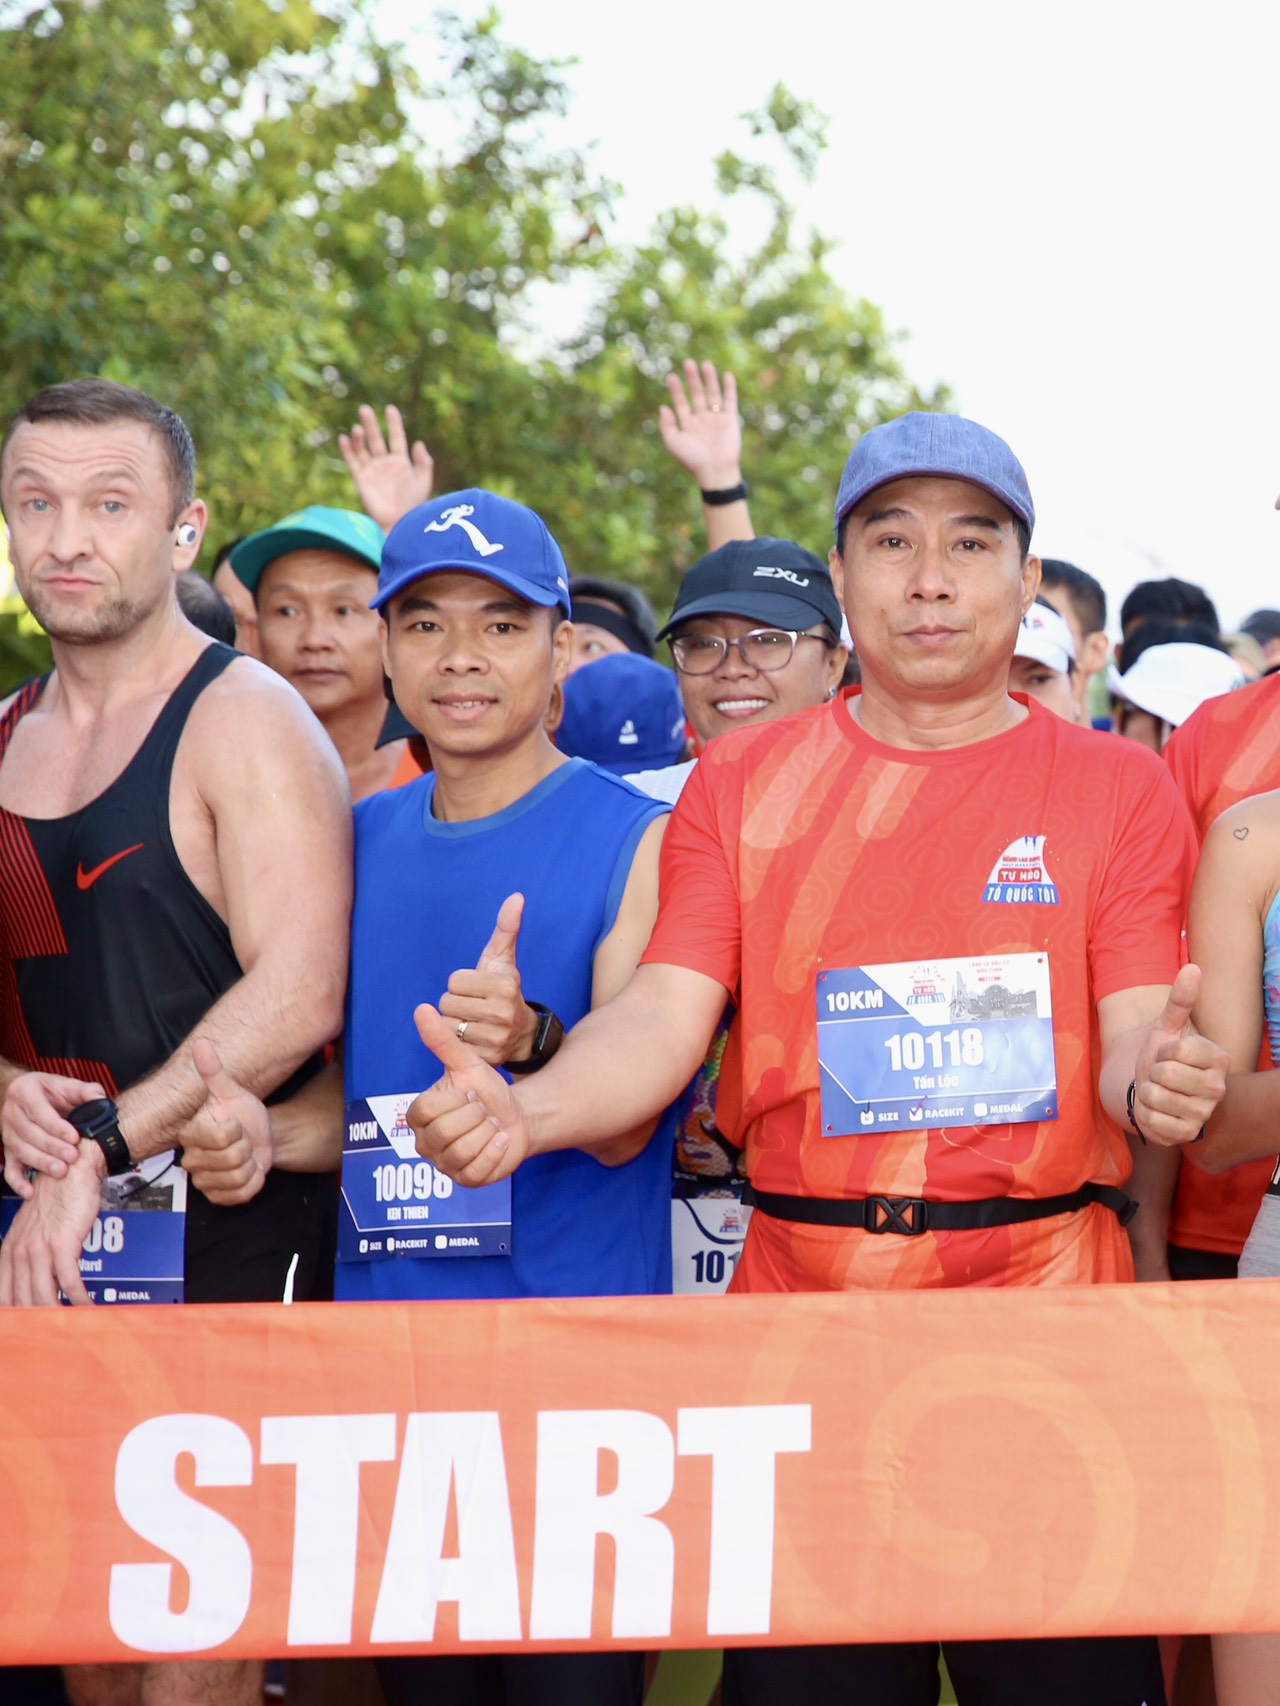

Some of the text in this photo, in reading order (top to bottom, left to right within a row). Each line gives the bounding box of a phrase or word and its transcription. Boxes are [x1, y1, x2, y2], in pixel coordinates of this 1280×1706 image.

[753, 566, 809, 587] 2XU
[826, 989, 884, 1012] 10KM
[885, 1028, 984, 1071] 10118
[878, 1111, 899, 1122] SIZE
[925, 1107, 965, 1119] RACEKIT
[990, 1104, 1023, 1115] MEDAL
[349, 1121, 378, 1142] 10KM
[372, 1162, 453, 1202] 10098
[387, 1205, 429, 1221] KEN THIEN
[370, 1240, 382, 1250] SIZE
[395, 1238, 428, 1249] RACEKIT
[449, 1237, 480, 1247] MEDAL
[118, 1291, 150, 1301] MEDAL
[108, 1403, 812, 1654] START
